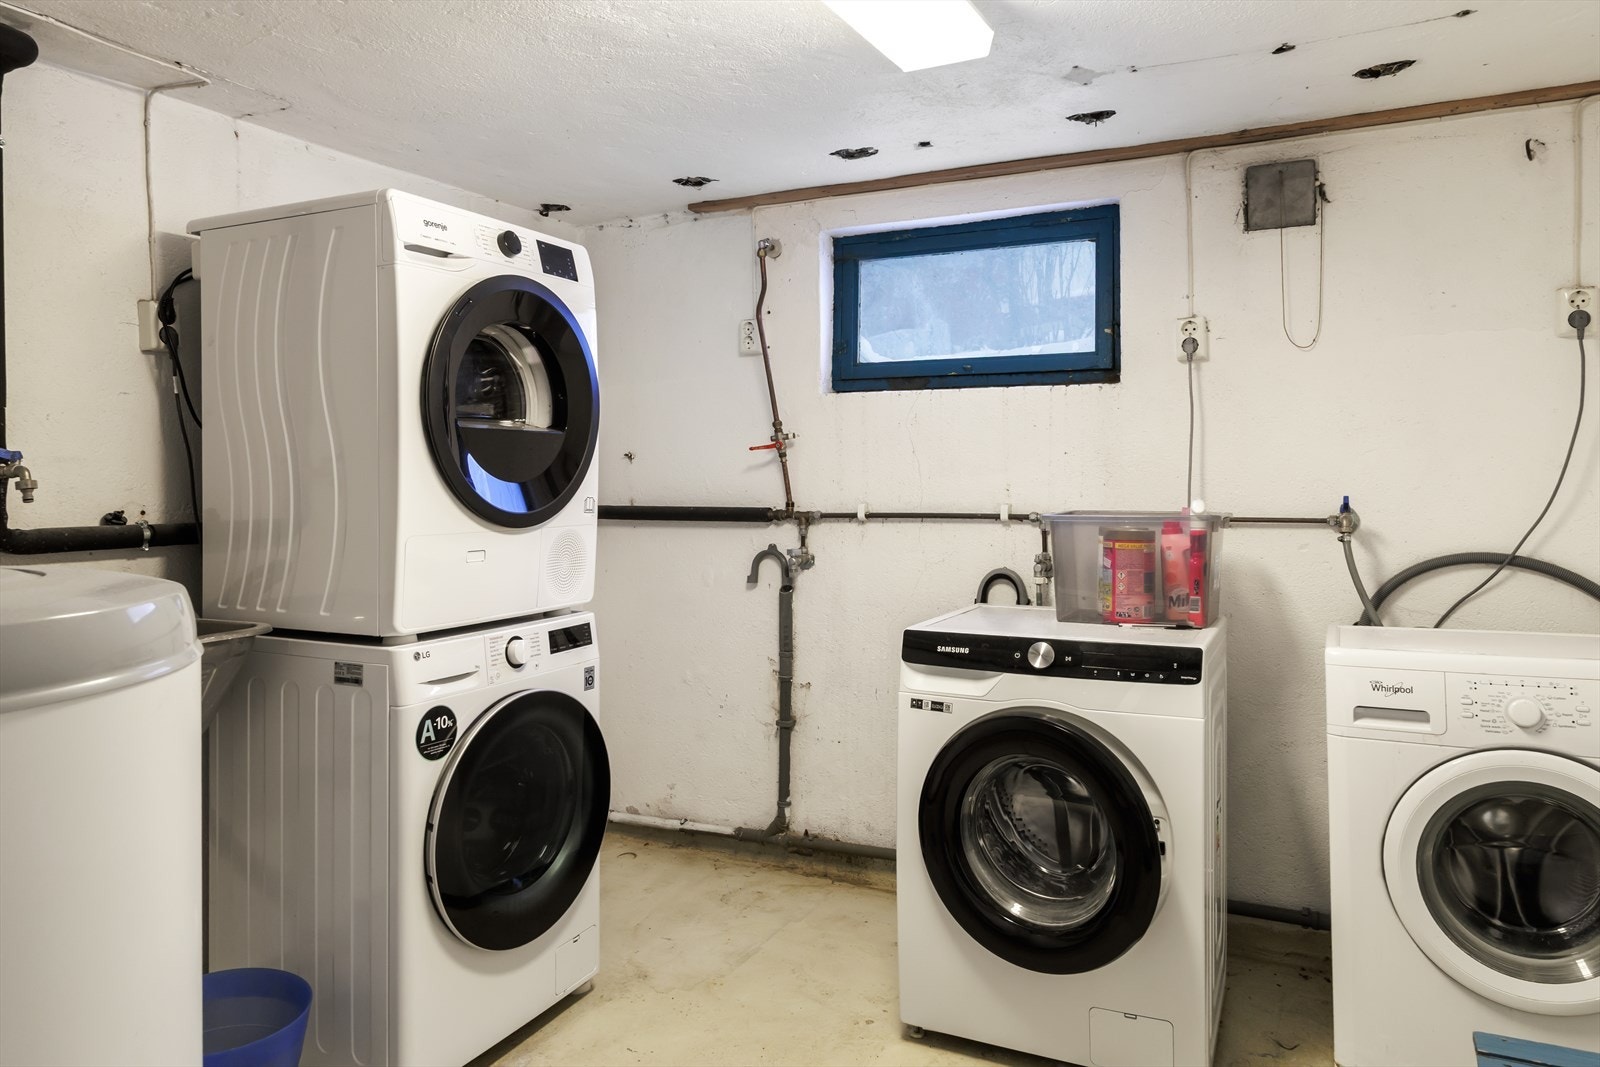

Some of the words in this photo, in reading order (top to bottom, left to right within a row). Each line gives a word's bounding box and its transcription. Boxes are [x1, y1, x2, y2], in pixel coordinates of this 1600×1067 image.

[423, 219, 448, 231] gorenje
[1168, 592, 1189, 610] Mil
[421, 650, 431, 659] LG
[936, 645, 970, 654] SAMSUNG
[1371, 682, 1414, 695] Whirlpool
